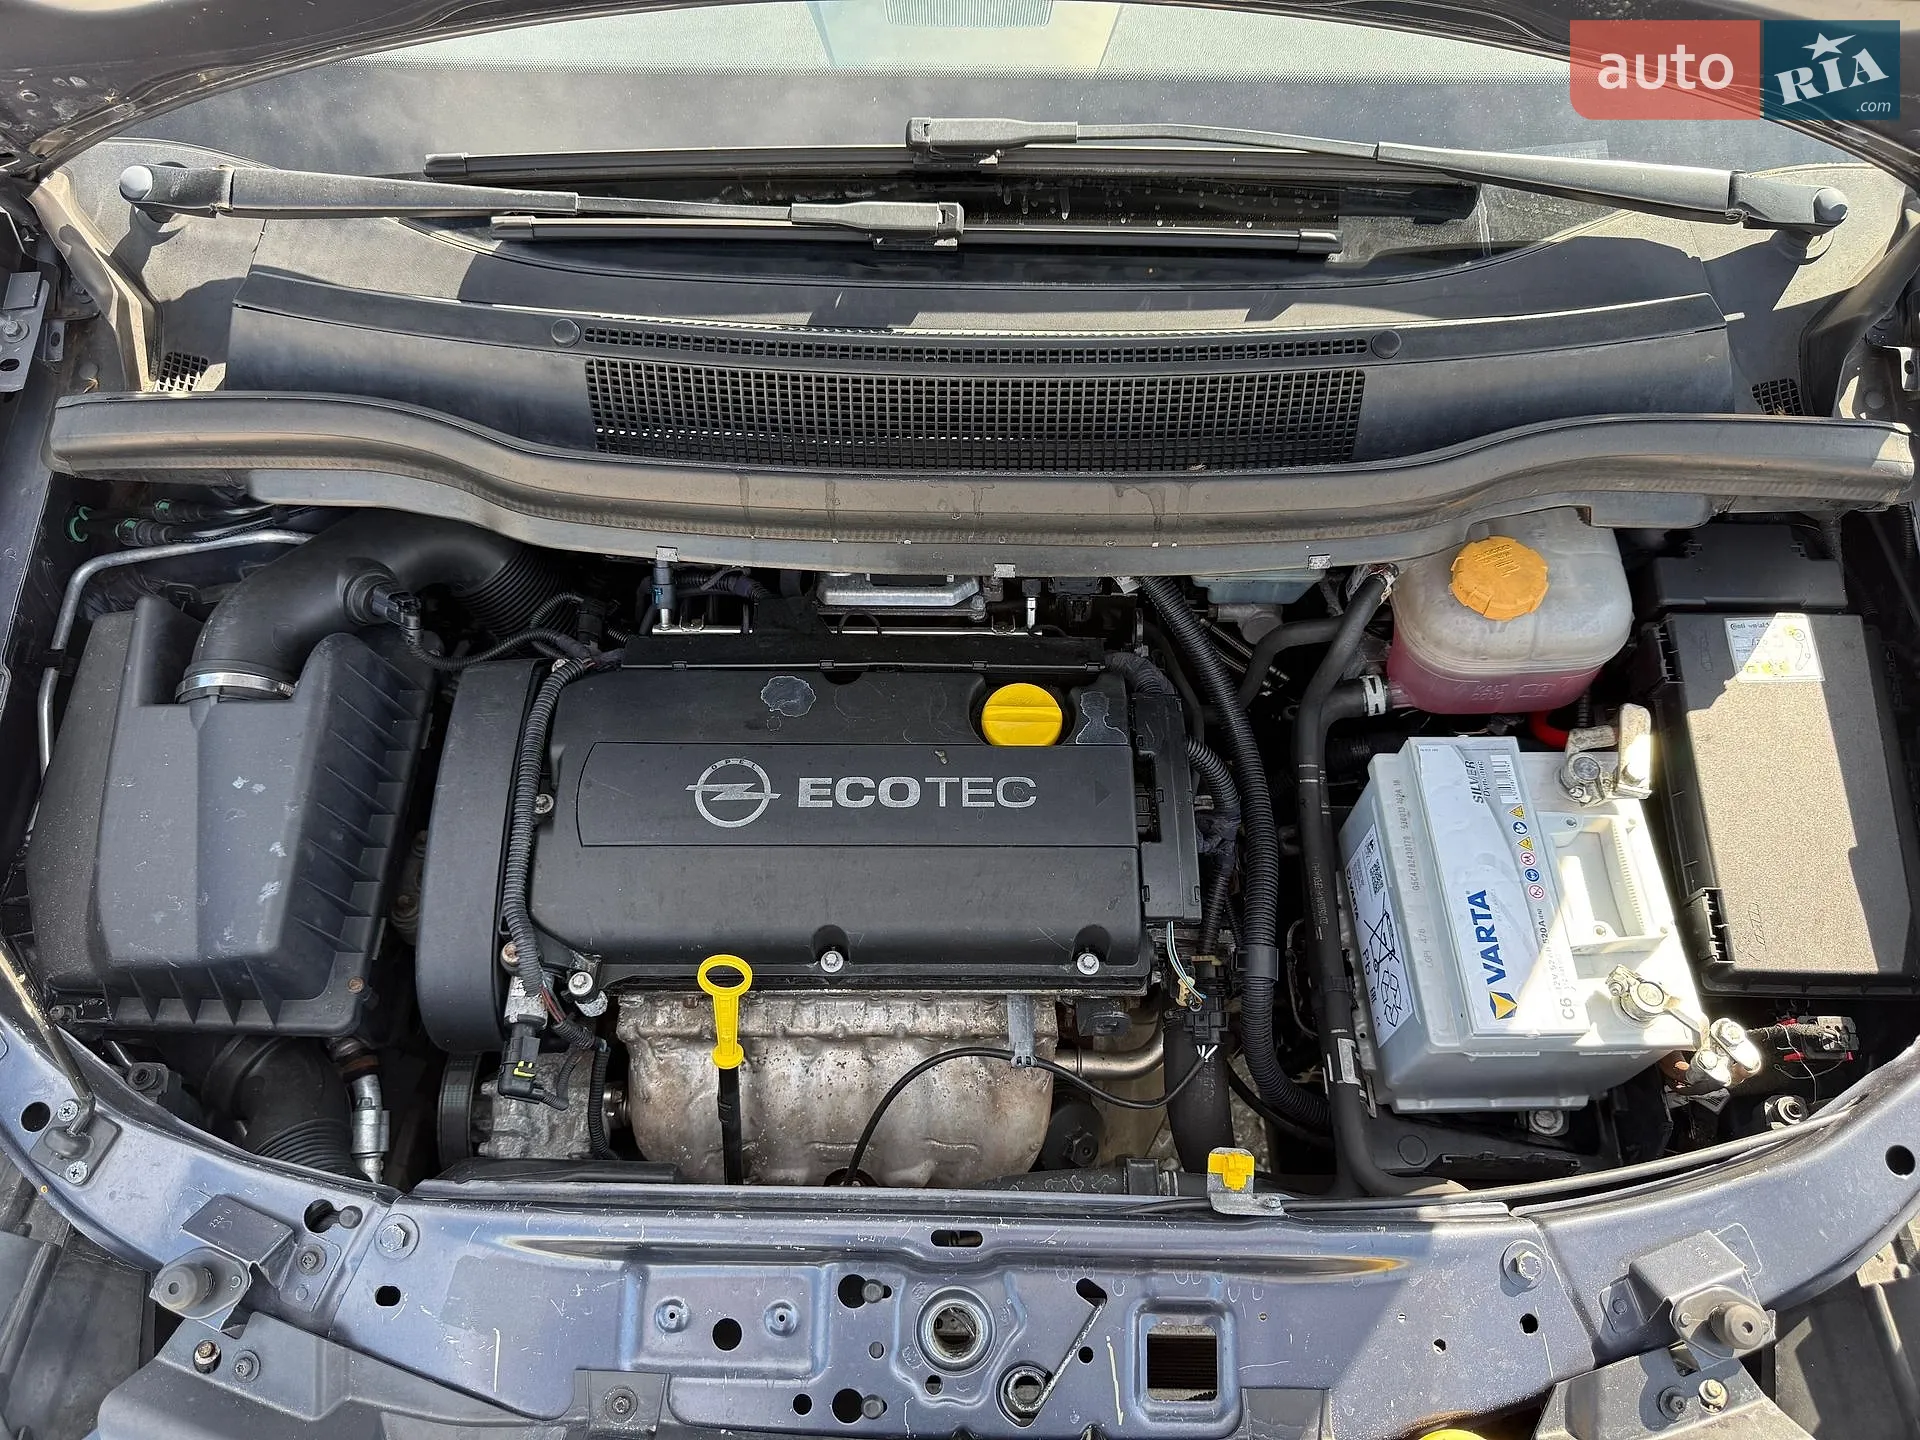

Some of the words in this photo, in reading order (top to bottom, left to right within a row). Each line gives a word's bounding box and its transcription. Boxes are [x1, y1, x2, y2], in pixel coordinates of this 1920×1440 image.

[711, 758, 757, 770] OPEL
[797, 776, 1038, 808] ECOTEC
[1464, 760, 1484, 804] SILVER
[1467, 890, 1506, 985] VARTA
[1362, 949, 1371, 976] Pb
[1559, 997, 1575, 1020] C6
